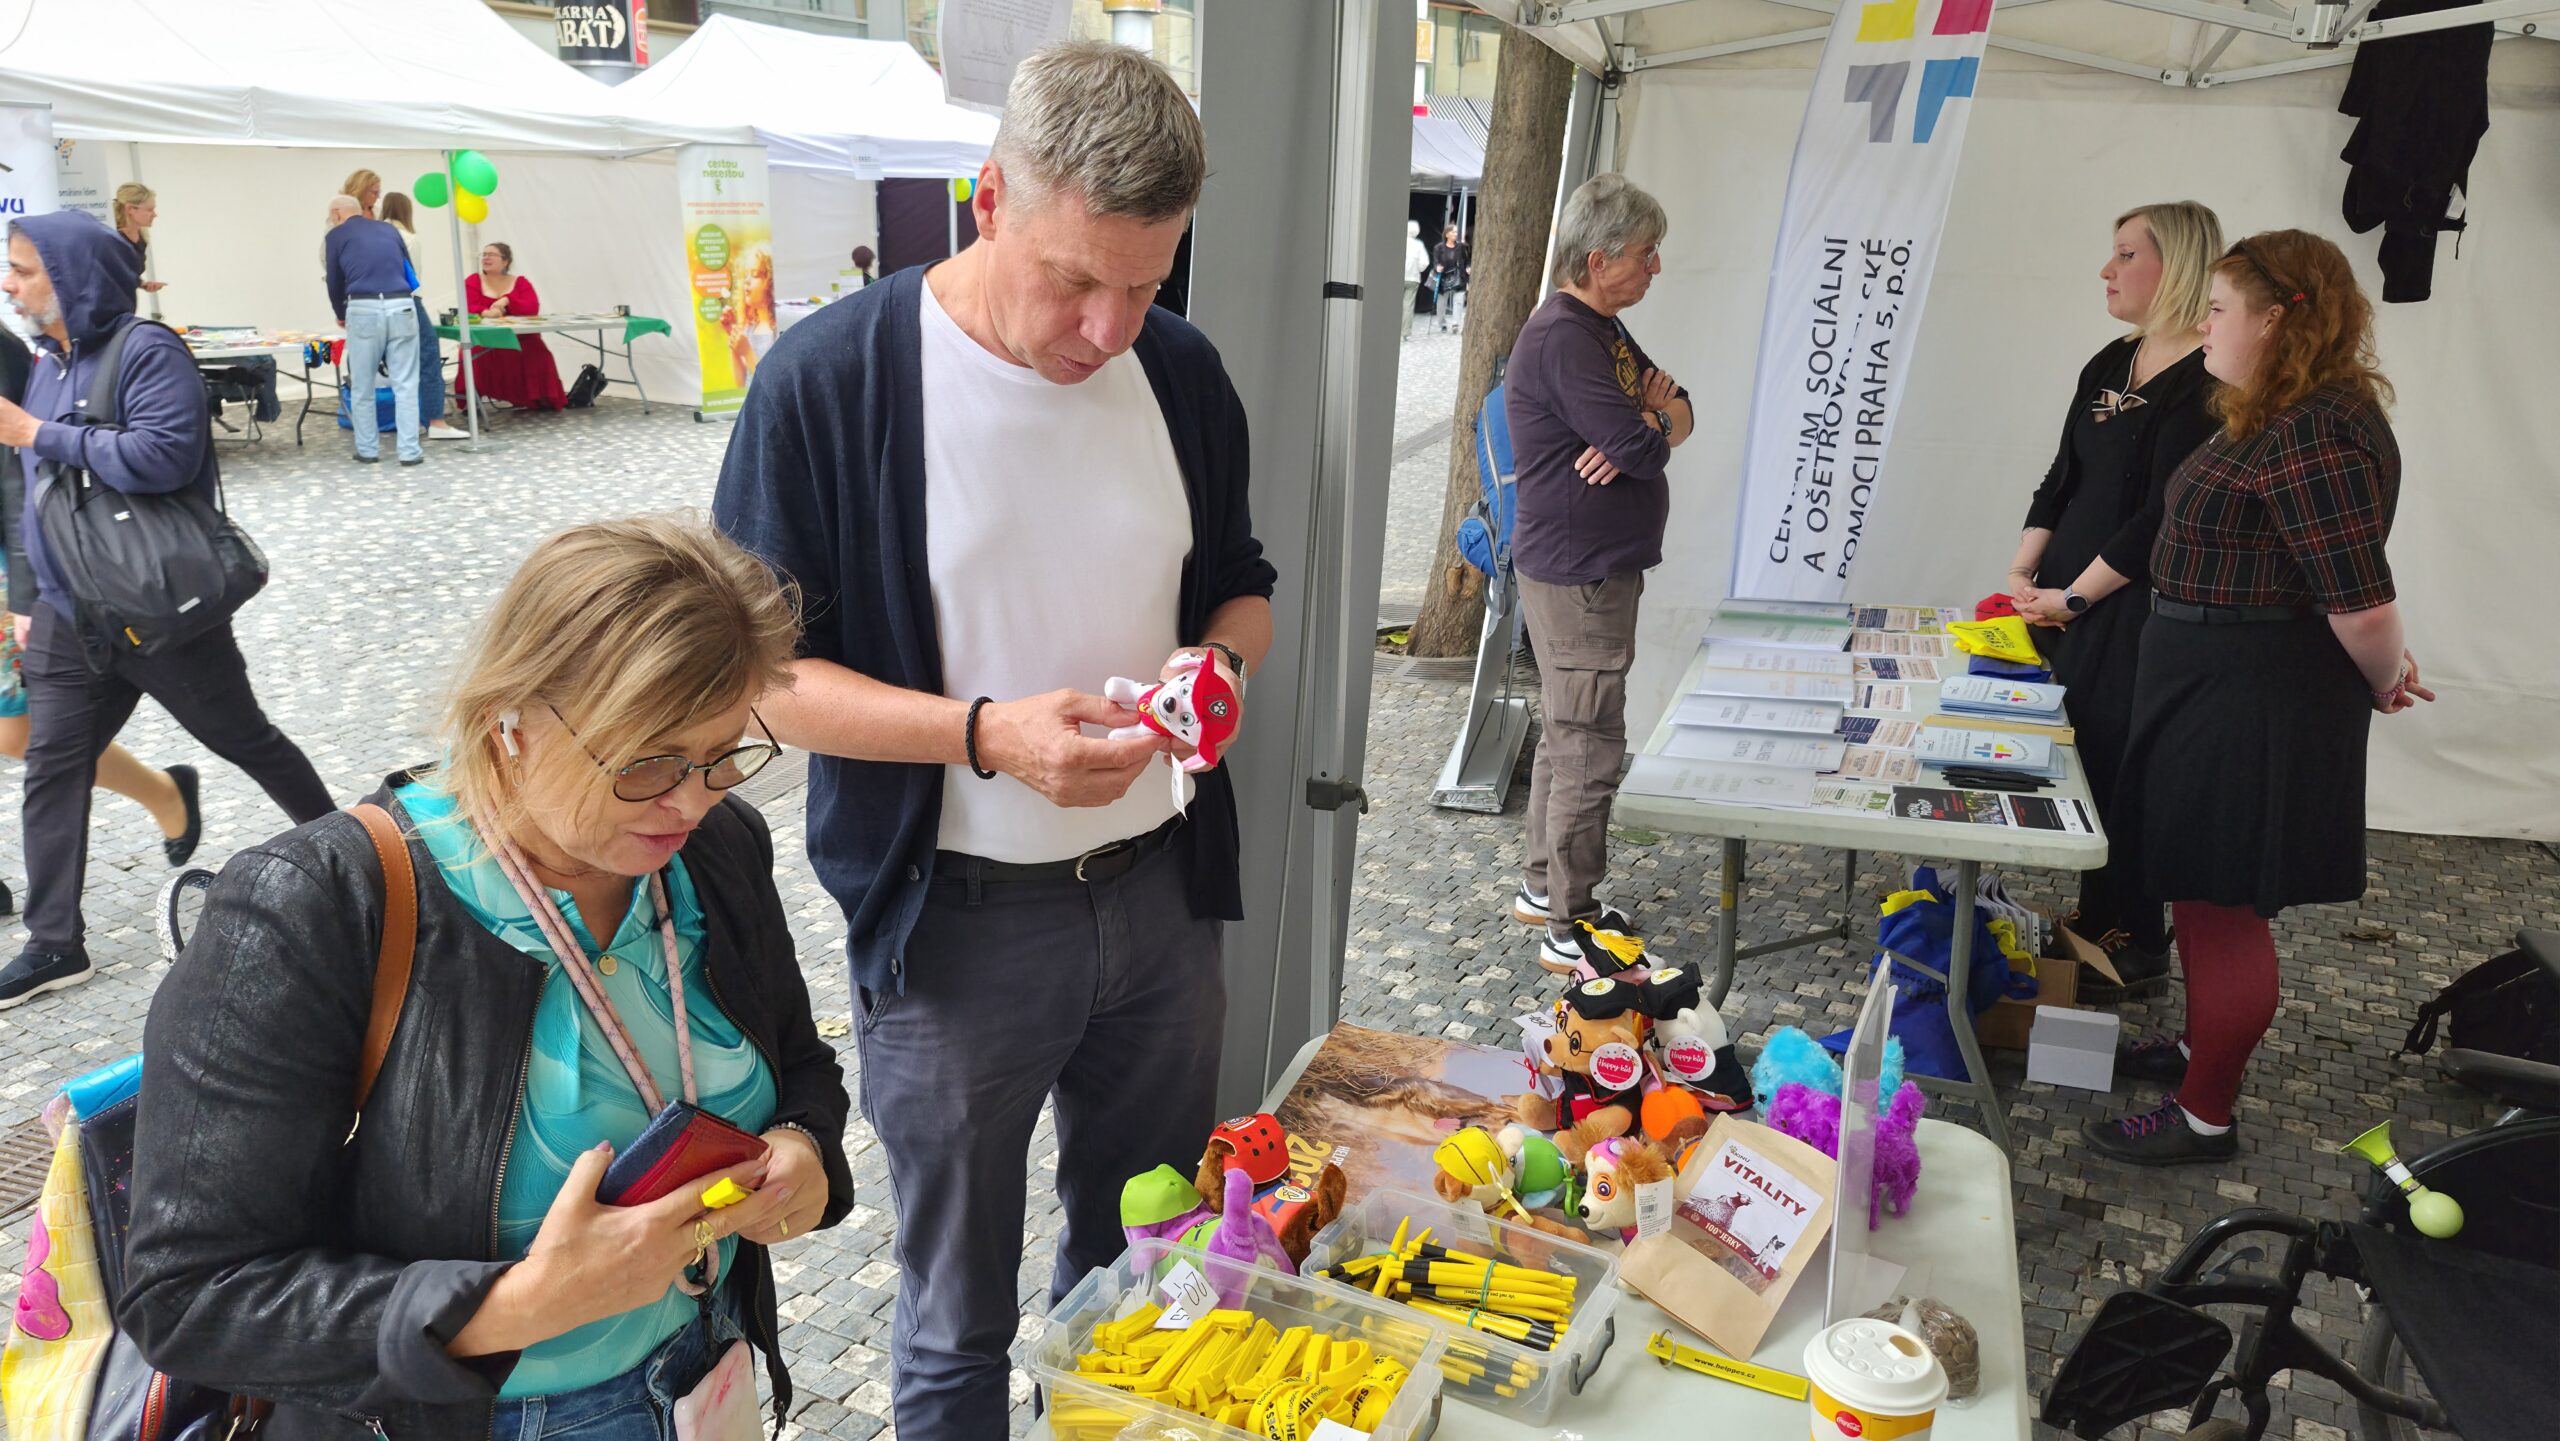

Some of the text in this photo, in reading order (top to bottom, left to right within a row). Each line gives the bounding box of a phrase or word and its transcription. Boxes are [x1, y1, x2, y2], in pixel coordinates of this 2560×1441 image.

[1806, 236, 1848, 395] SOCIÁLNÍ
[1837, 239, 1913, 580] POMOCI PRAHA 5, p.o.
[1803, 551, 1826, 573] A
[1599, 1058, 1620, 1072] Happy
[1671, 1050, 1692, 1062] Happy
[1724, 1155, 1807, 1216] VITALITY
[1719, 1232, 1742, 1249] JERKY
[1694, 1357, 1756, 1379] www.helppes.cz
